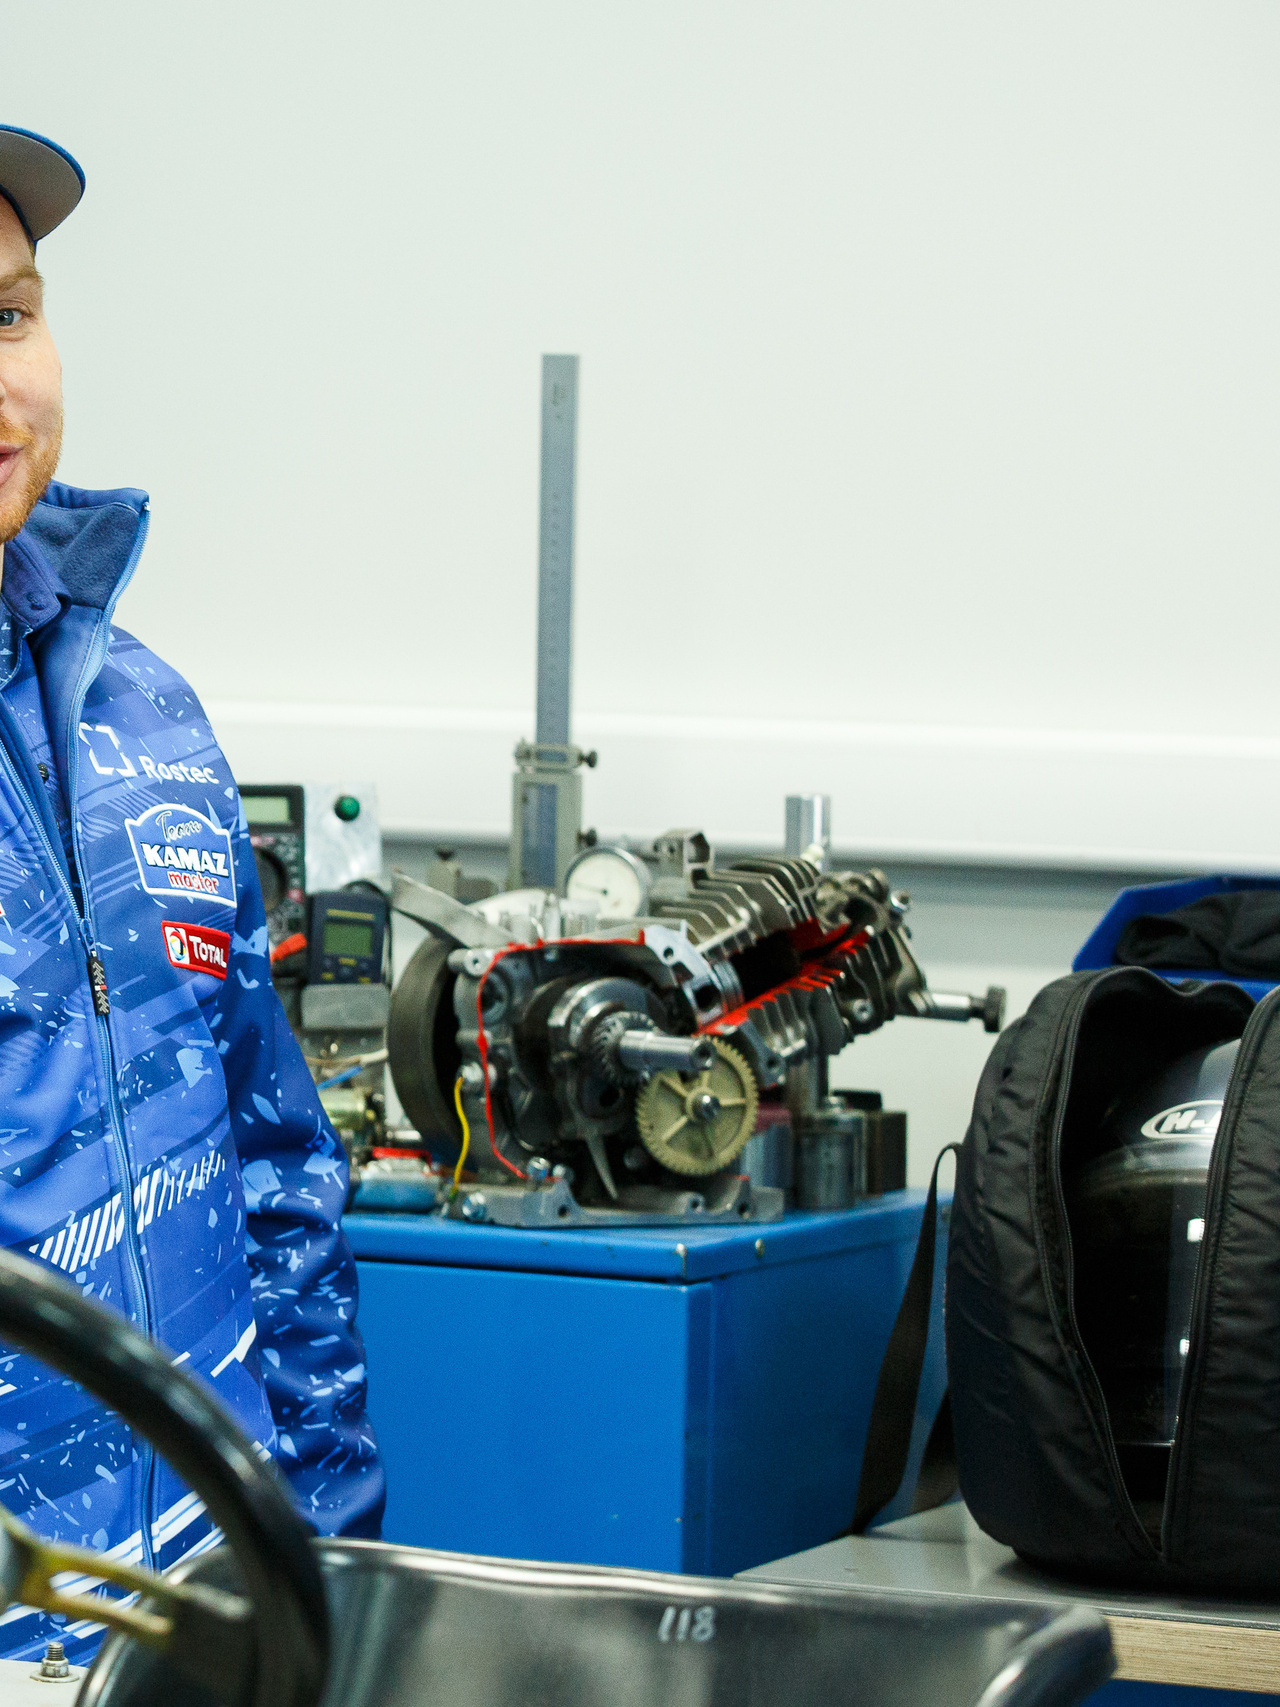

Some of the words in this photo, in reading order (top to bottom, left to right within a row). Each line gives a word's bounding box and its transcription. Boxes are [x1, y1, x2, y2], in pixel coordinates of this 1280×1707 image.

[138, 755, 220, 785] Rostec
[155, 810, 202, 843] Team
[140, 841, 229, 878] KAMAZ
[167, 870, 219, 894] master
[188, 934, 228, 969] TOTAL
[658, 1605, 717, 1642] 118
